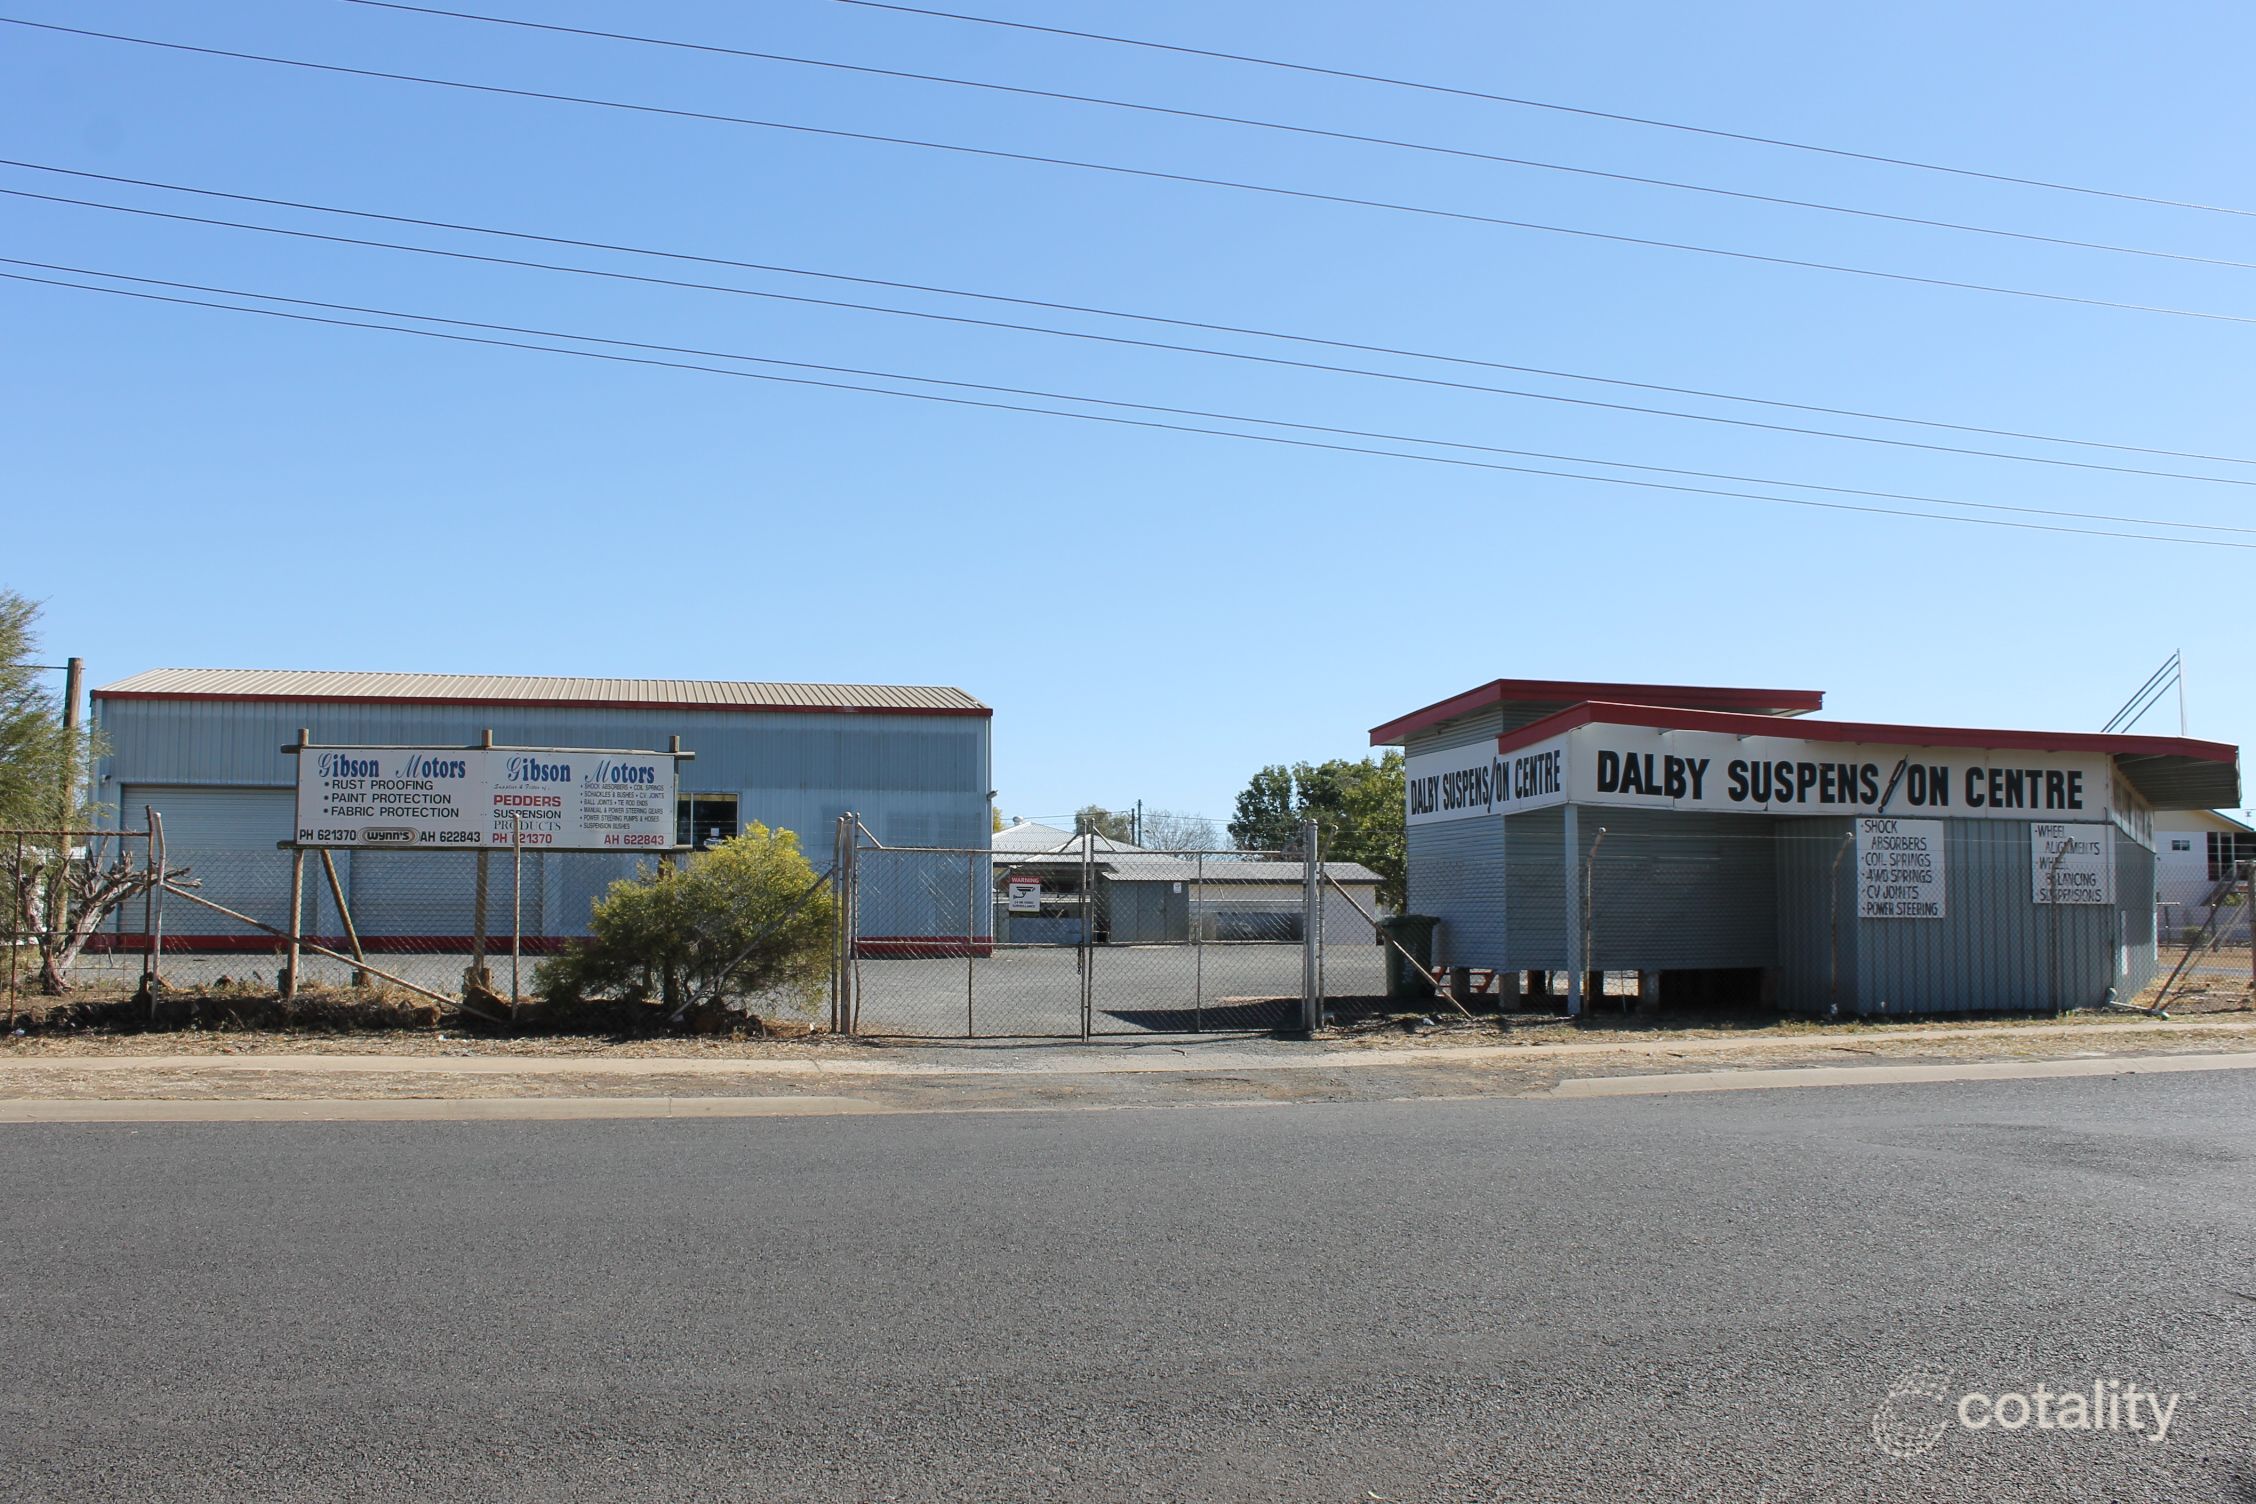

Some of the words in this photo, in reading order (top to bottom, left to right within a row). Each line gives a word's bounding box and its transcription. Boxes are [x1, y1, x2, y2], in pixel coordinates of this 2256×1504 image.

[318, 753, 380, 778] Gibson
[395, 754, 466, 779] Motors
[506, 757, 571, 782] Gibson
[584, 760, 655, 784] Motors
[332, 780, 365, 790] RUST
[370, 780, 434, 791] PROOFING
[1410, 775, 1440, 816] DALBY
[1514, 750, 1561, 799] CENTRE
[1597, 750, 1711, 800] DALBY
[1965, 766, 2083, 810] CENTRE
[331, 793, 367, 803] PAINT
[371, 793, 452, 804] PROTECTION
[493, 795, 562, 807] PEDDERS
[331, 806, 375, 817] FABRIC
[379, 807, 460, 818] PROTECTION
[493, 809, 562, 819] SUSPENSION
[1864, 820, 1898, 833] SHOCK
[2037, 825, 2065, 838] WHEEL
[299, 829, 314, 841] PH
[317, 829, 357, 841] 621370
[420, 831, 436, 843] AH
[440, 831, 481, 843] 622843
[492, 833, 507, 844] PH
[603, 834, 620, 845] AH
[623, 834, 665, 845] 622843
[1871, 836, 1927, 851] ABSORBERS
[1865, 852, 1887, 866] COIL
[1889, 852, 1931, 867] SPRINGS
[1890, 869, 1932, 883] SPRINGS
[1866, 885, 1881, 899] CV
[1883, 885, 1919, 899] JOINTS
[1866, 901, 1894, 915] POWER
[1896, 902, 1938, 916] STEERING
